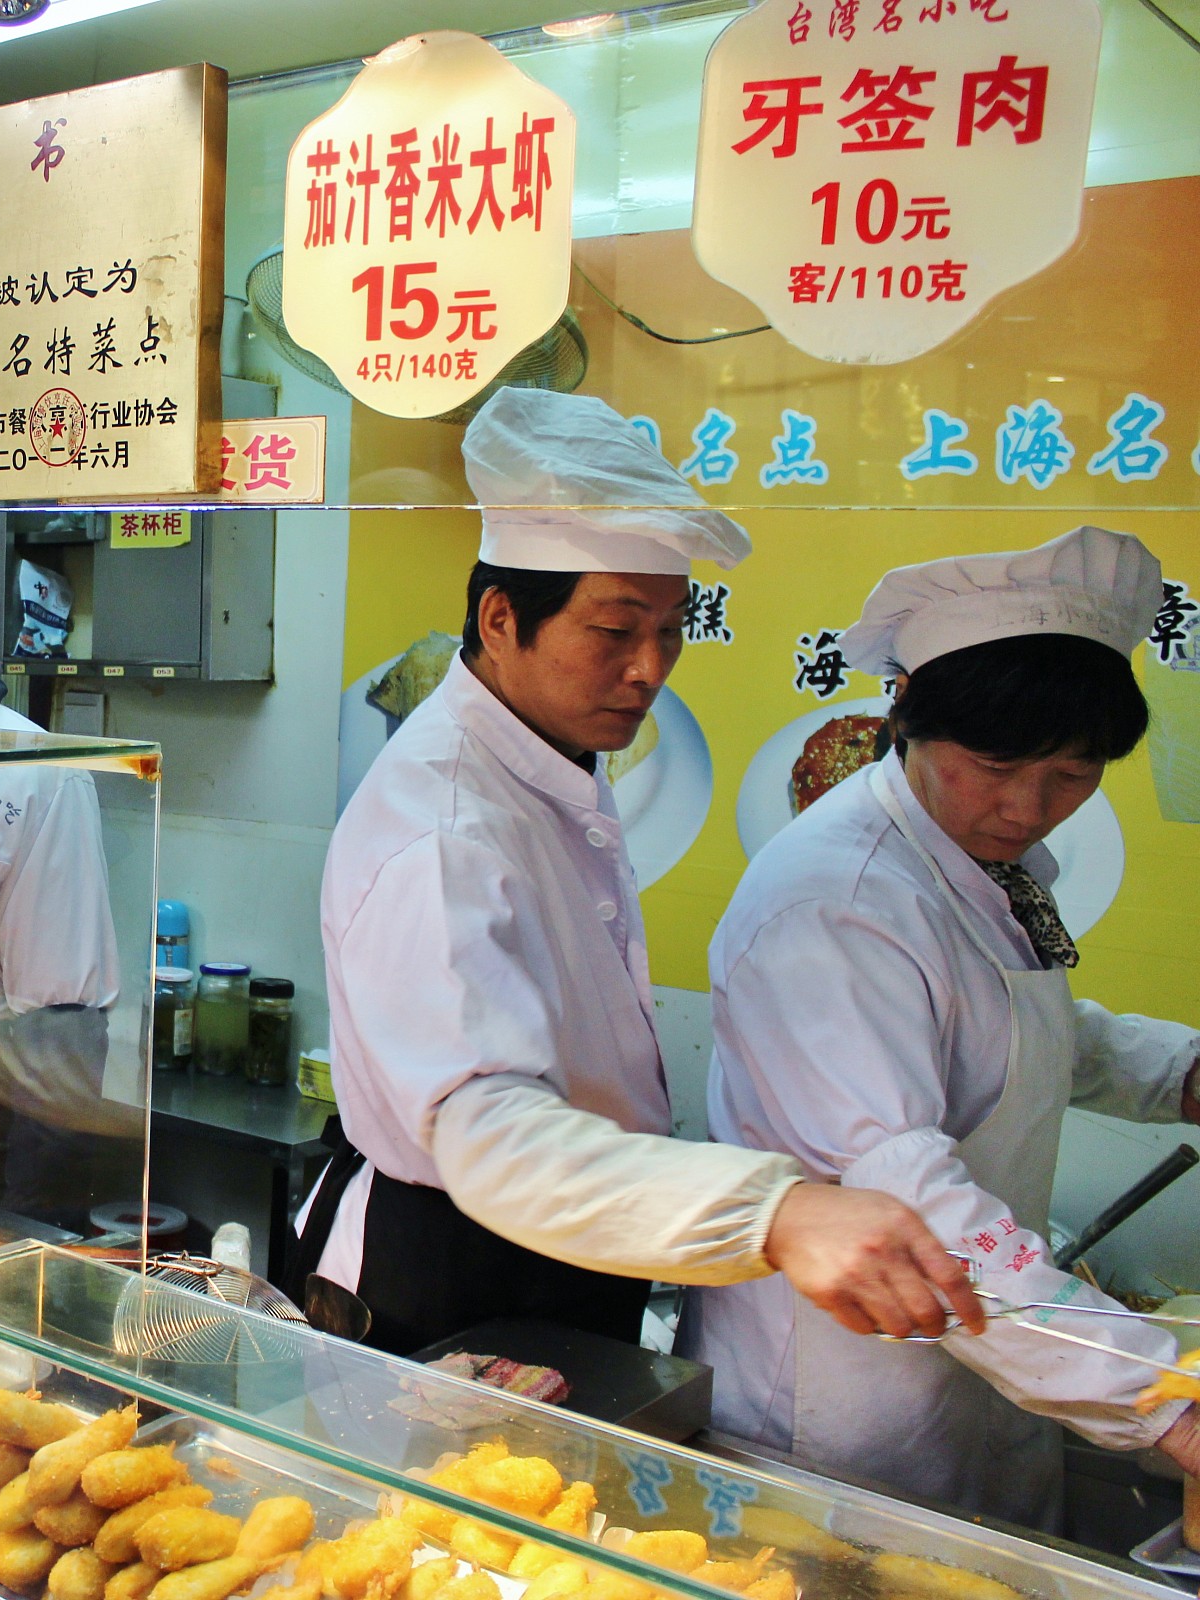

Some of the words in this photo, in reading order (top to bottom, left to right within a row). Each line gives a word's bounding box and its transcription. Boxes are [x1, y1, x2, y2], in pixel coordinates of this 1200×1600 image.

[732, 55, 1050, 158] 牙签肉
[303, 111, 556, 250] 茄汁香米大虾
[810, 178, 951, 247] 10元
[351, 261, 498, 343] 15元
[787, 259, 968, 304] 客/110克
[356, 348, 478, 382] 4只/140克
[632, 411, 826, 485] 名点
[907, 396, 1200, 483] 上海名
[120, 512, 183, 538] 茶杯柜
